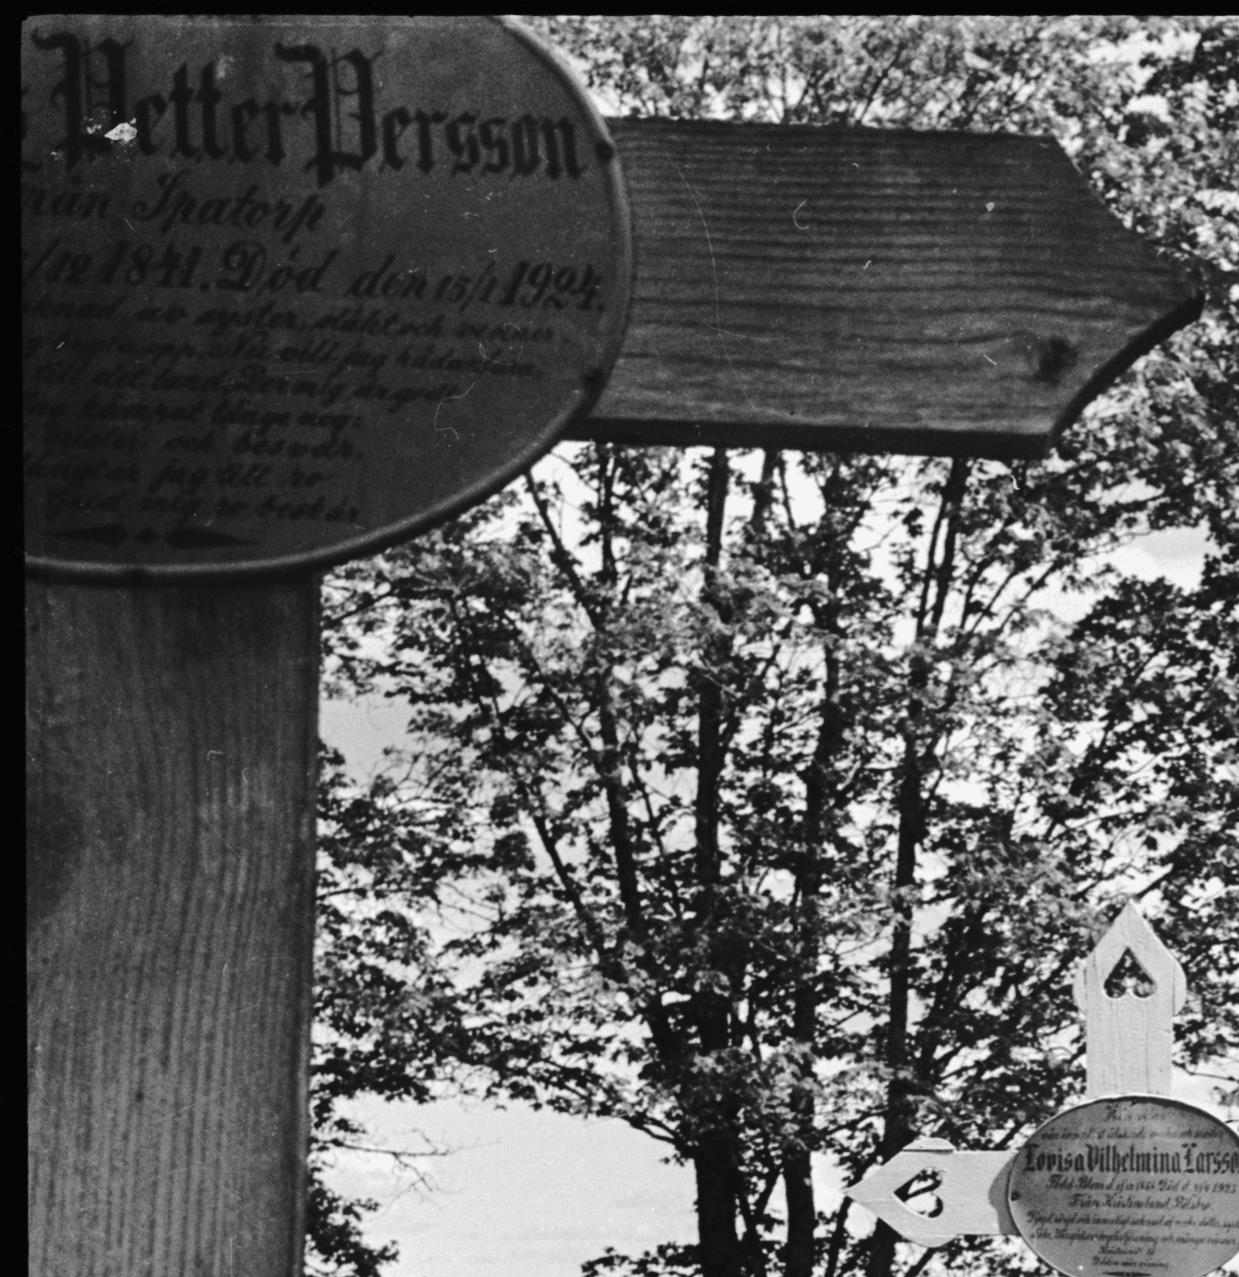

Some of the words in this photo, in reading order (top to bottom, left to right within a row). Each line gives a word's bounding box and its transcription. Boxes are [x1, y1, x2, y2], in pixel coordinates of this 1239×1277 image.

[31, 26, 301, 171] Petter
[273, 40, 587, 188] Persson
[215, 239, 339, 292] Död
[347, 253, 427, 300] den
[1022, 1143, 1085, 1173] Lovisa
[1085, 1143, 1181, 1175] Vilhelmina
